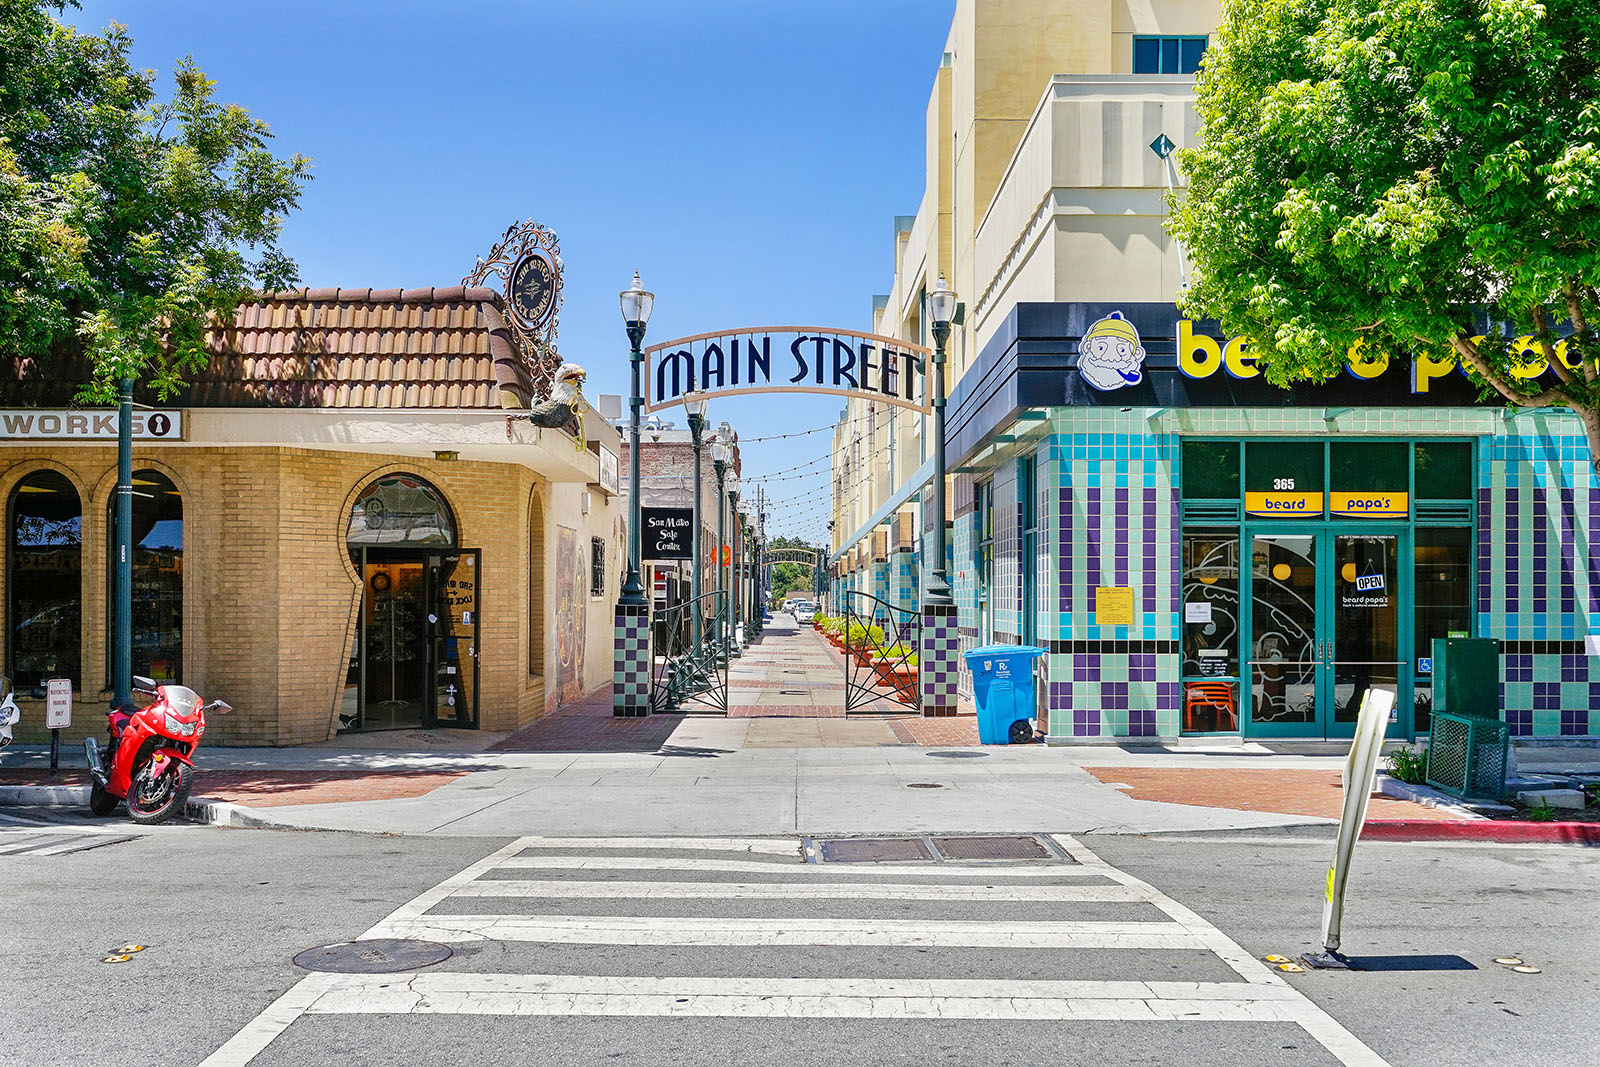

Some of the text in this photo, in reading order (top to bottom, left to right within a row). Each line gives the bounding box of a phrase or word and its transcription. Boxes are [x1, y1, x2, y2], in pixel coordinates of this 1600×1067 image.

[515, 293, 528, 317] LOCK
[657, 335, 921, 402] MAIN STREET
[1273, 478, 1295, 490] 365
[1265, 497, 1391, 511] beard papa's
[648, 517, 690, 528] San Mateo
[660, 529, 678, 541] Safe
[656, 540, 681, 551] Center
[1358, 577, 1382, 589] OPEN
